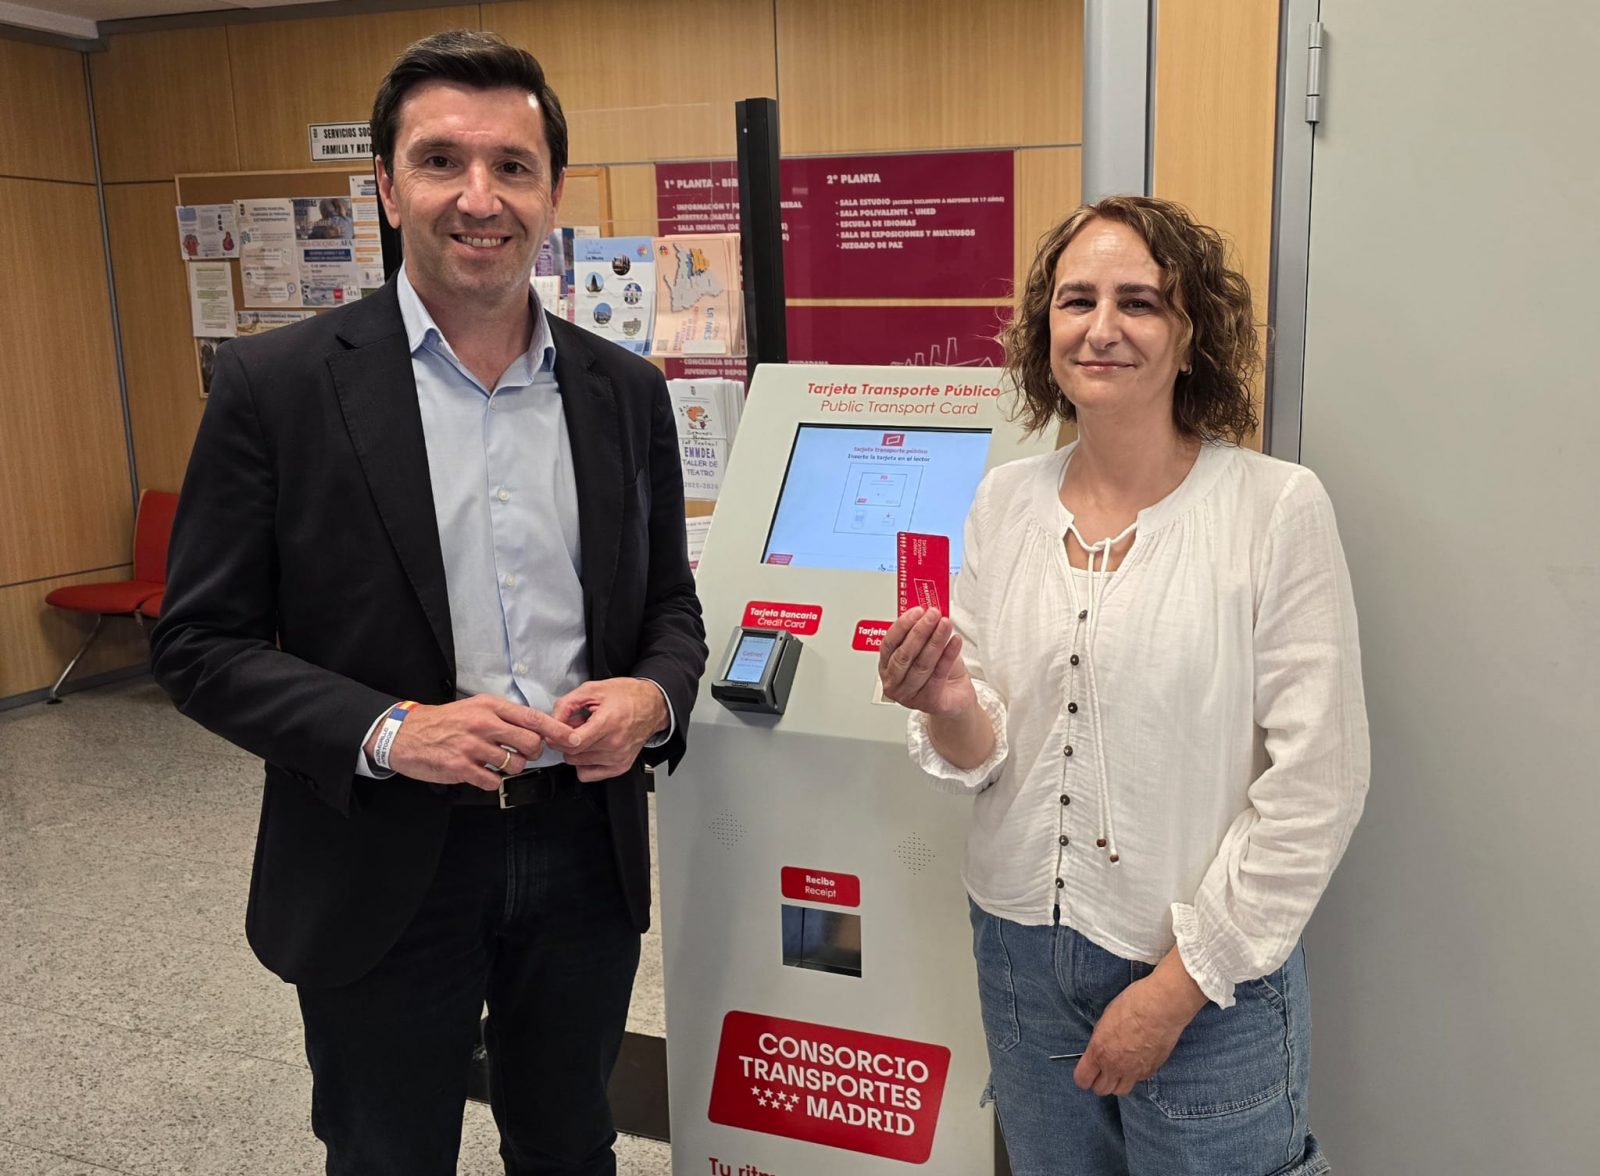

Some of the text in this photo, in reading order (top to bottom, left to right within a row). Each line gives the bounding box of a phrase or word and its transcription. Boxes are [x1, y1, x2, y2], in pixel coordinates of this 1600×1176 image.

[324, 128, 356, 138] SERVICIOS
[322, 144, 348, 154] FAMILIA
[350, 144, 354, 154] Y
[676, 178, 714, 188] PLANTA
[840, 173, 881, 184] PLANTA
[859, 198, 891, 206] ESTUDIO
[840, 209, 858, 217] SALA
[860, 208, 908, 216] POLIVALENTE
[914, 208, 936, 216] UNED
[884, 219, 917, 227] IDIOMAS
[840, 231, 860, 239] SALA
[871, 230, 925, 238] EXPOSICIONES
[925, 230, 931, 238] Y
[932, 228, 976, 237] MULTIUSOS
[840, 240, 904, 250] JUZGADO DE PAZ
[808, 383, 1000, 399] Tarjeta Transporte Público
[820, 400, 978, 416] Public Transport Card
[684, 447, 716, 460] EMMDEA
[682, 459, 720, 469] TALLER DE
[686, 468, 715, 478] TEATRO
[750, 607, 818, 620] Tarjeta Bancaria
[757, 616, 806, 629] Credit Card
[858, 626, 887, 637] Tarjeta
[806, 874, 836, 886] Recibo
[804, 886, 836, 898] Receipt
[758, 1032, 929, 1084] CONSORCIO
[738, 1055, 921, 1110] TRANSPORTES
[806, 1094, 915, 1136] MADRID
[708, 1156, 731, 1176] Tu
